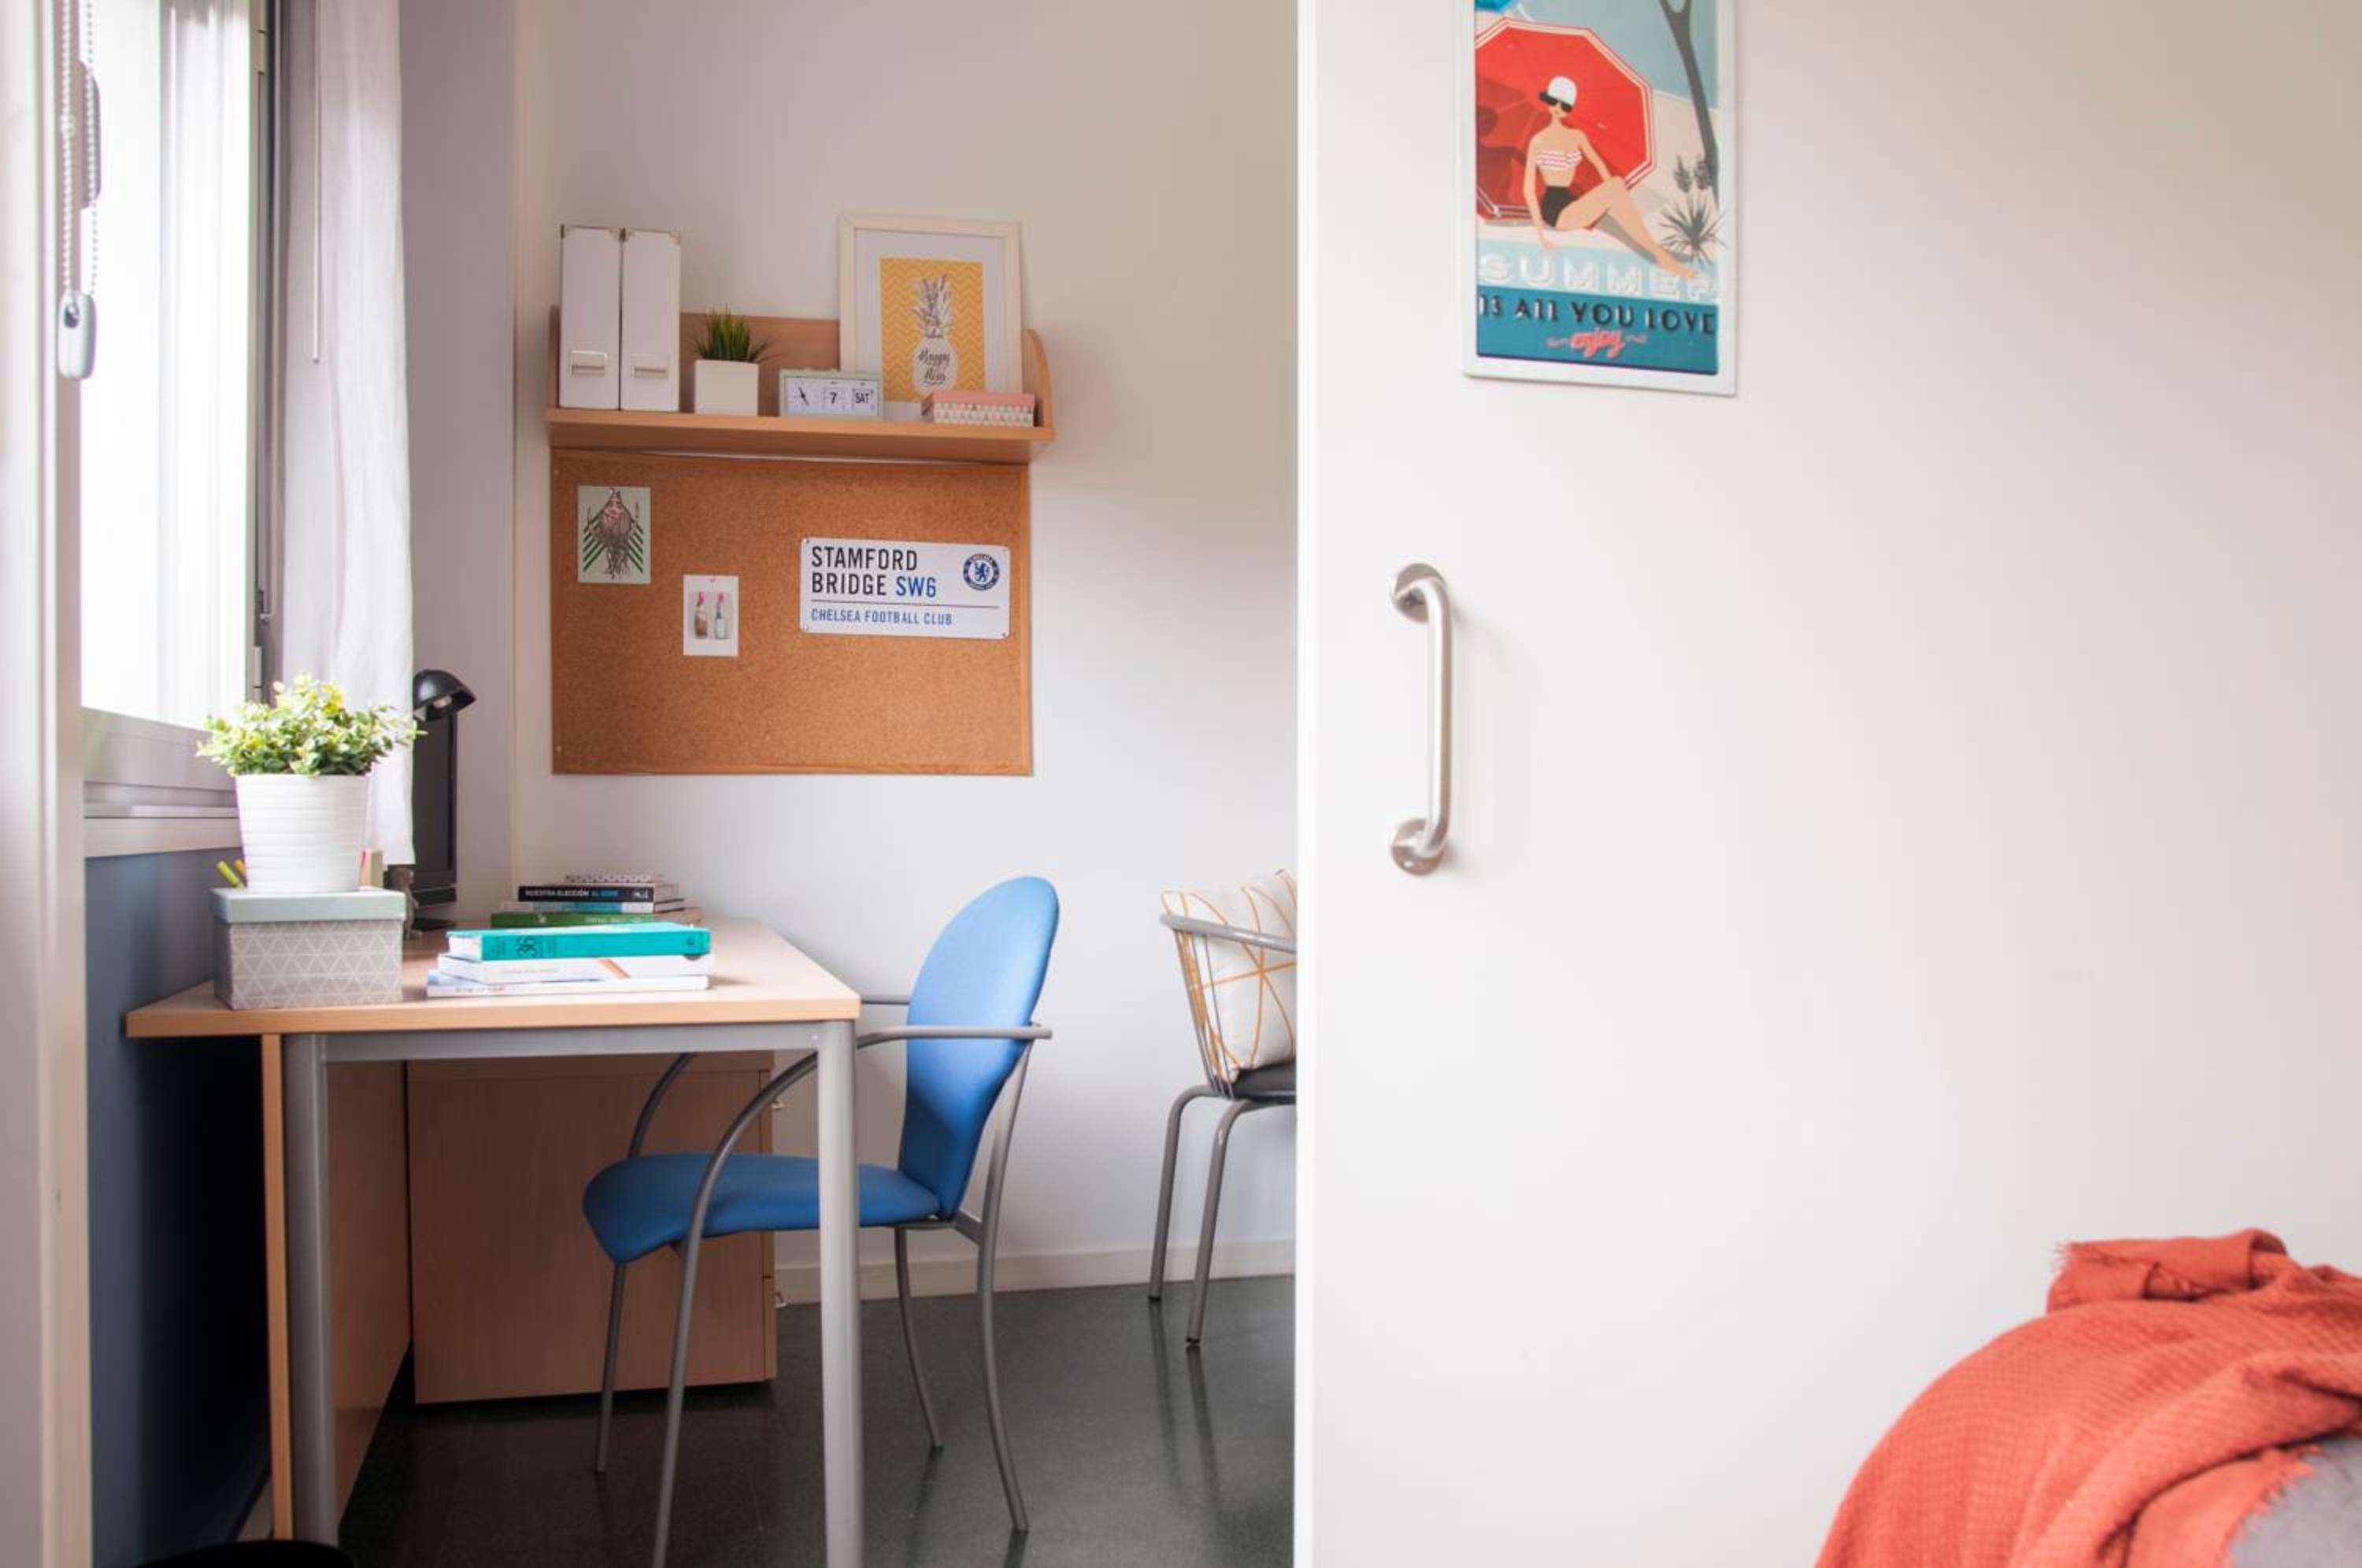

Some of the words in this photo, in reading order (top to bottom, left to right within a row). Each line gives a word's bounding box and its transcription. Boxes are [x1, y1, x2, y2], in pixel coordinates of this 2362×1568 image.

[1571, 301, 1635, 328] YOU
[1645, 308, 1716, 335] LOVE
[1570, 327, 1626, 359] enjoy
[829, 391, 838, 405] 7
[854, 392, 870, 405] SAT
[811, 545, 918, 571] STAMFORD
[811, 571, 887, 596] BRIDGE
[895, 575, 937, 598] SW6
[810, 608, 861, 623] CHELSEA
[864, 610, 920, 625] FOOTBALL
[924, 612, 953, 626] CLUB
